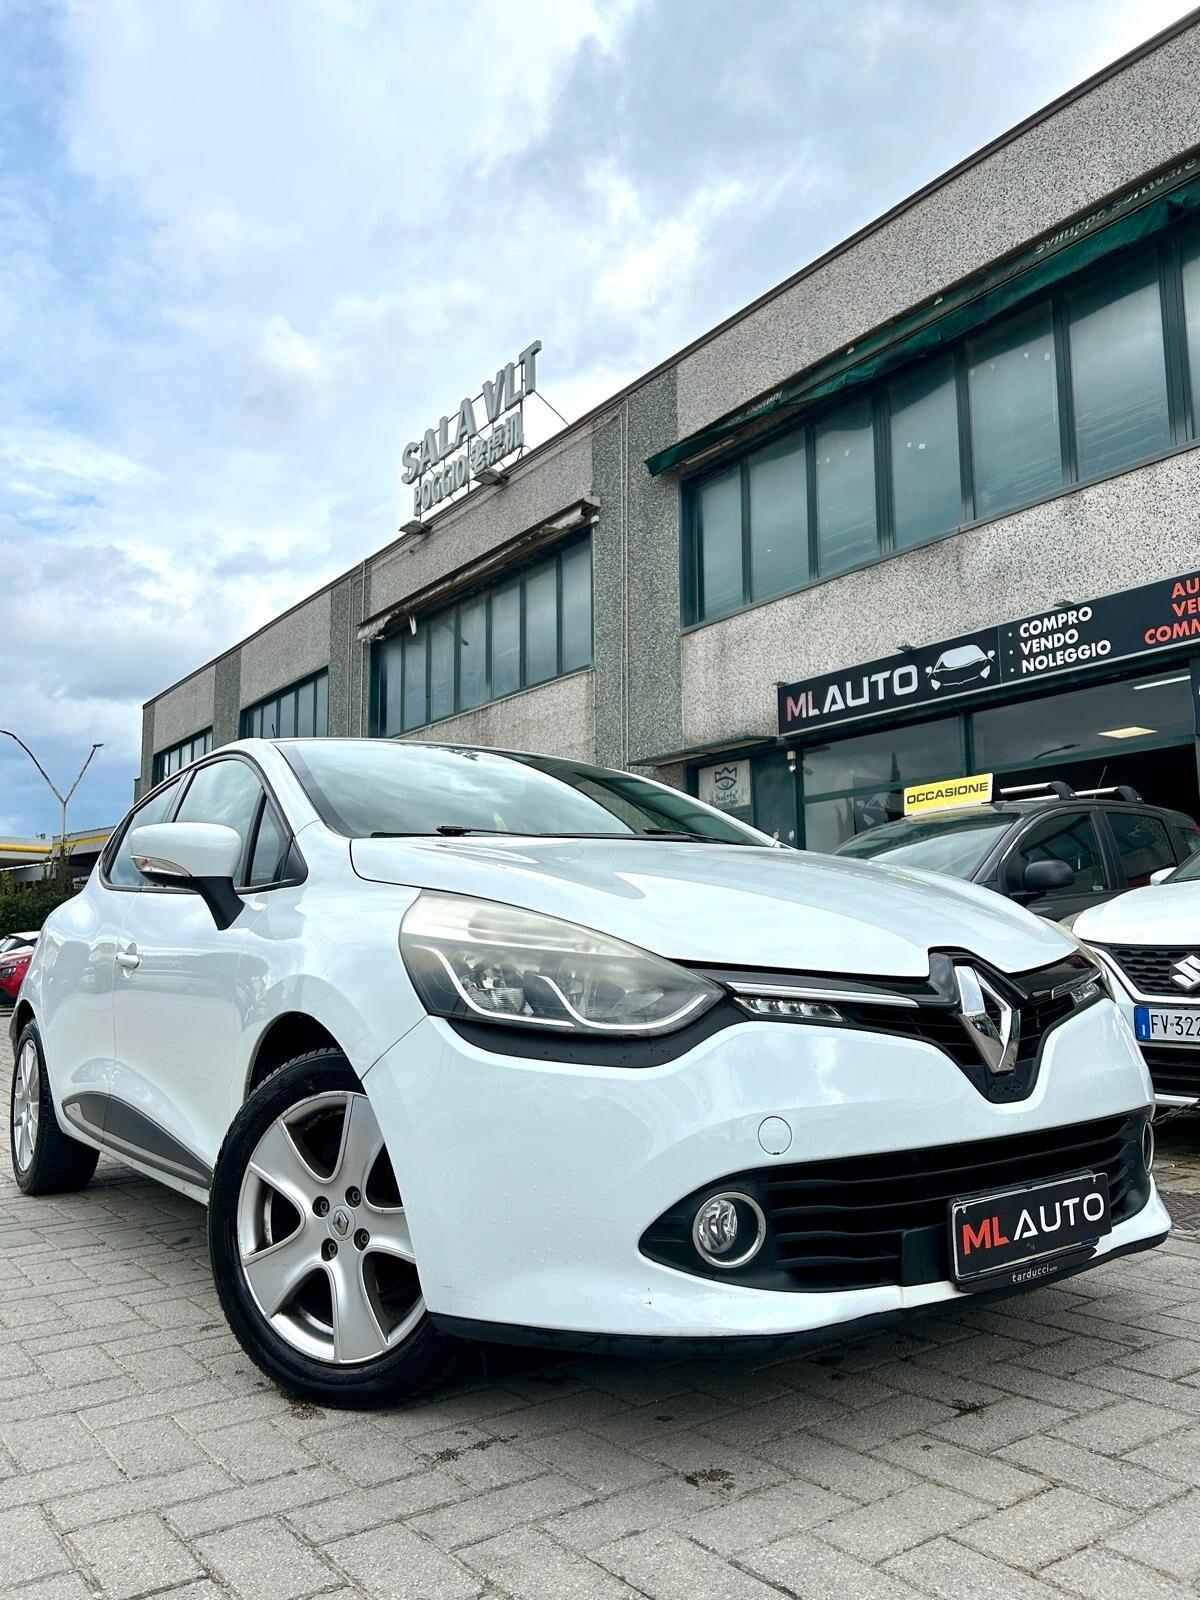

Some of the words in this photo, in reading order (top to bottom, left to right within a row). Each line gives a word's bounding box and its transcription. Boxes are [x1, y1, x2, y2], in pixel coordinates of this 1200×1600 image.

[401, 397, 477, 484] SALA
[482, 340, 542, 423] VLT
[414, 455, 469, 516] POGGIO
[1020, 606, 1092, 637] COMPRO
[1171, 597, 1200, 617] VE
[1020, 628, 1079, 655] VENDO
[1021, 640, 1111, 673] NOLEGGIO
[823, 664, 919, 713] AUTO
[906, 782, 989, 804] OCCASIONE
[962, 1216, 1010, 1255] ML
[1013, 1192, 1105, 1241] AUTO
[1012, 1263, 1049, 1283] tarducci
